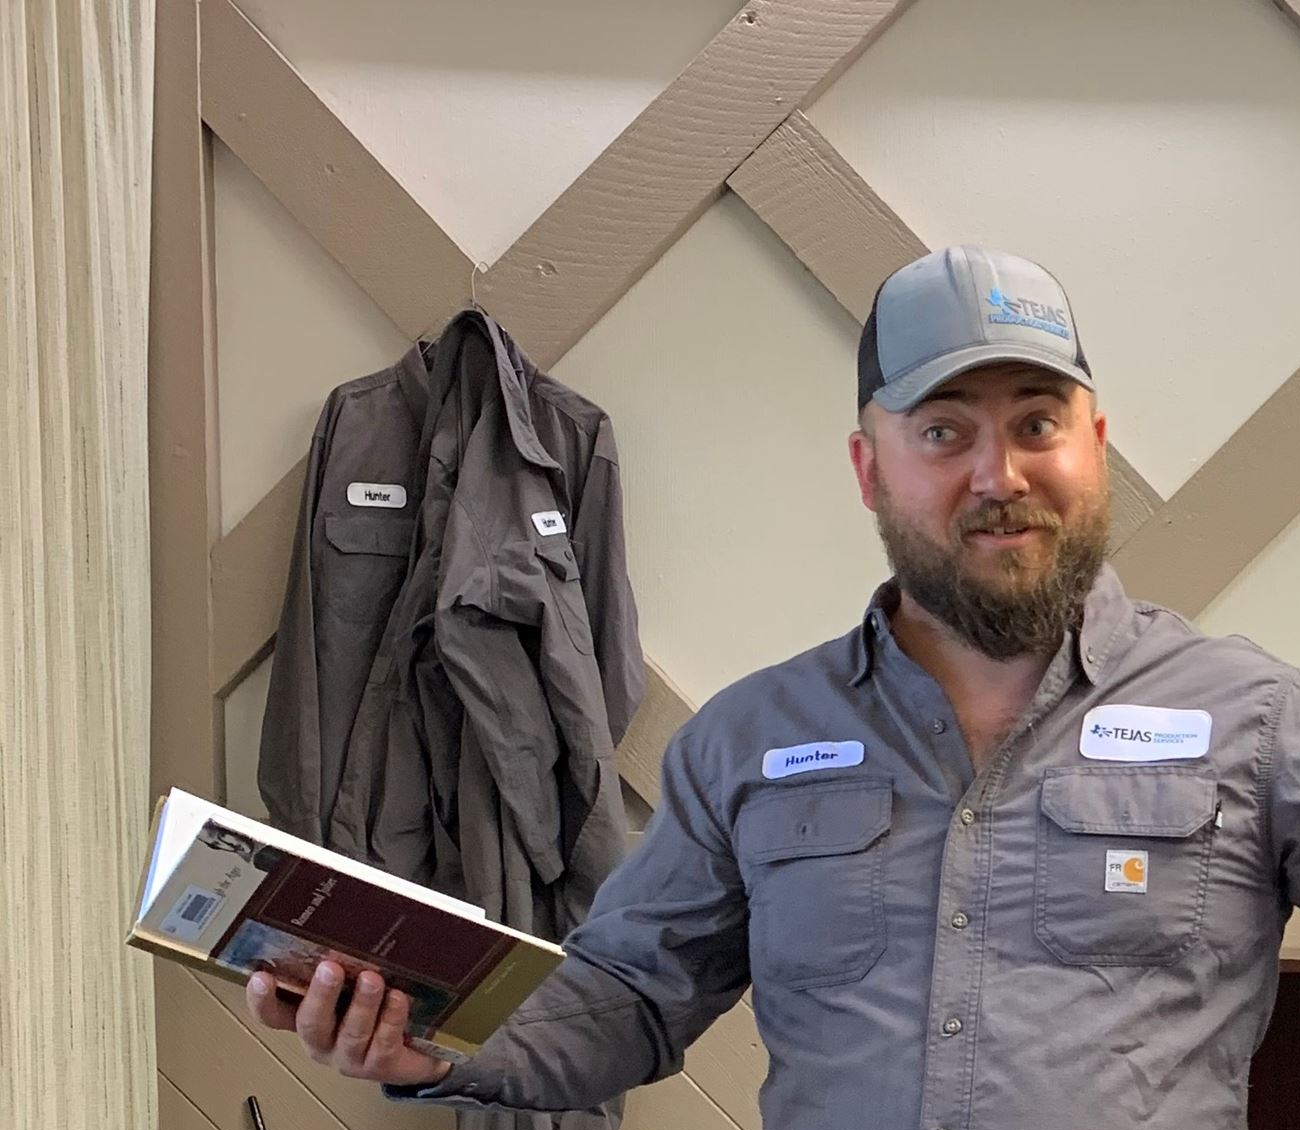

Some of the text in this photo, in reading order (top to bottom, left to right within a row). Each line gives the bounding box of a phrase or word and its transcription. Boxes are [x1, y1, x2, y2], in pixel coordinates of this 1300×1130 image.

[1017, 298, 1067, 328] TEJAS
[364, 490, 391, 502] Hunter
[1113, 727, 1152, 743] TEJAS
[785, 750, 839, 767] Hunter
[1109, 863, 1122, 872] FR
[290, 904, 317, 928] Romeo
